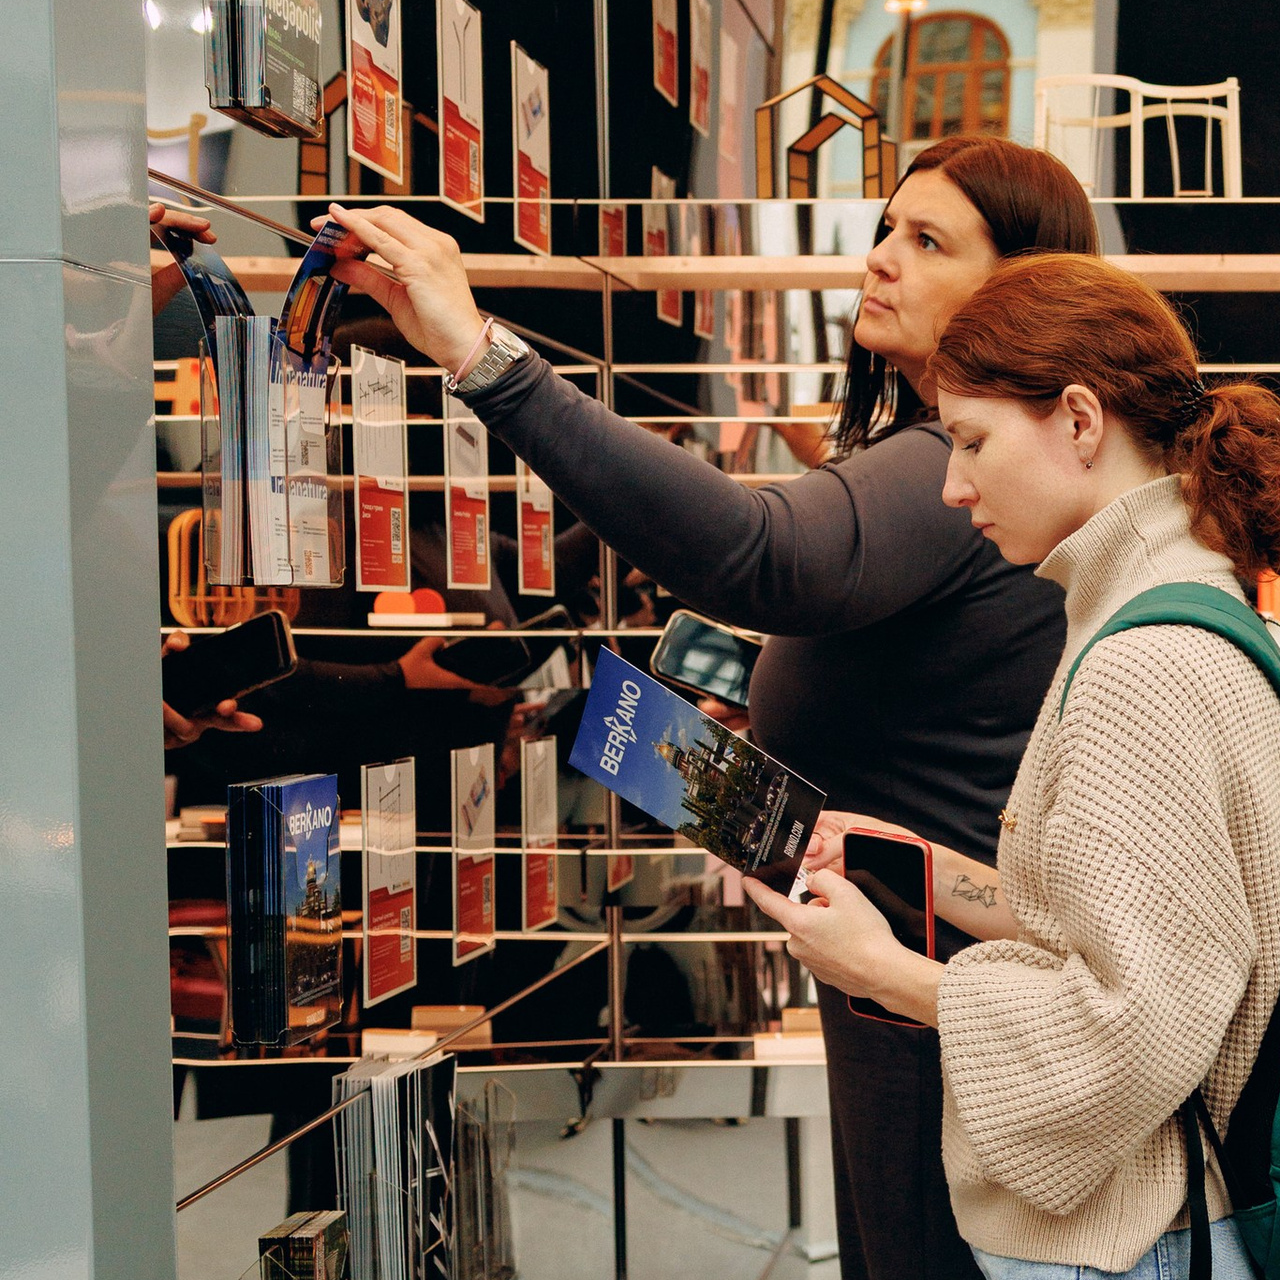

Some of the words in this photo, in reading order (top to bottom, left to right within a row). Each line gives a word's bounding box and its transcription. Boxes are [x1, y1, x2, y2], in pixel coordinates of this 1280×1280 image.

[599, 679, 642, 776] BERKANO
[290, 802, 331, 840] BERKANO
[784, 820, 805, 858] BRKNO.COM
